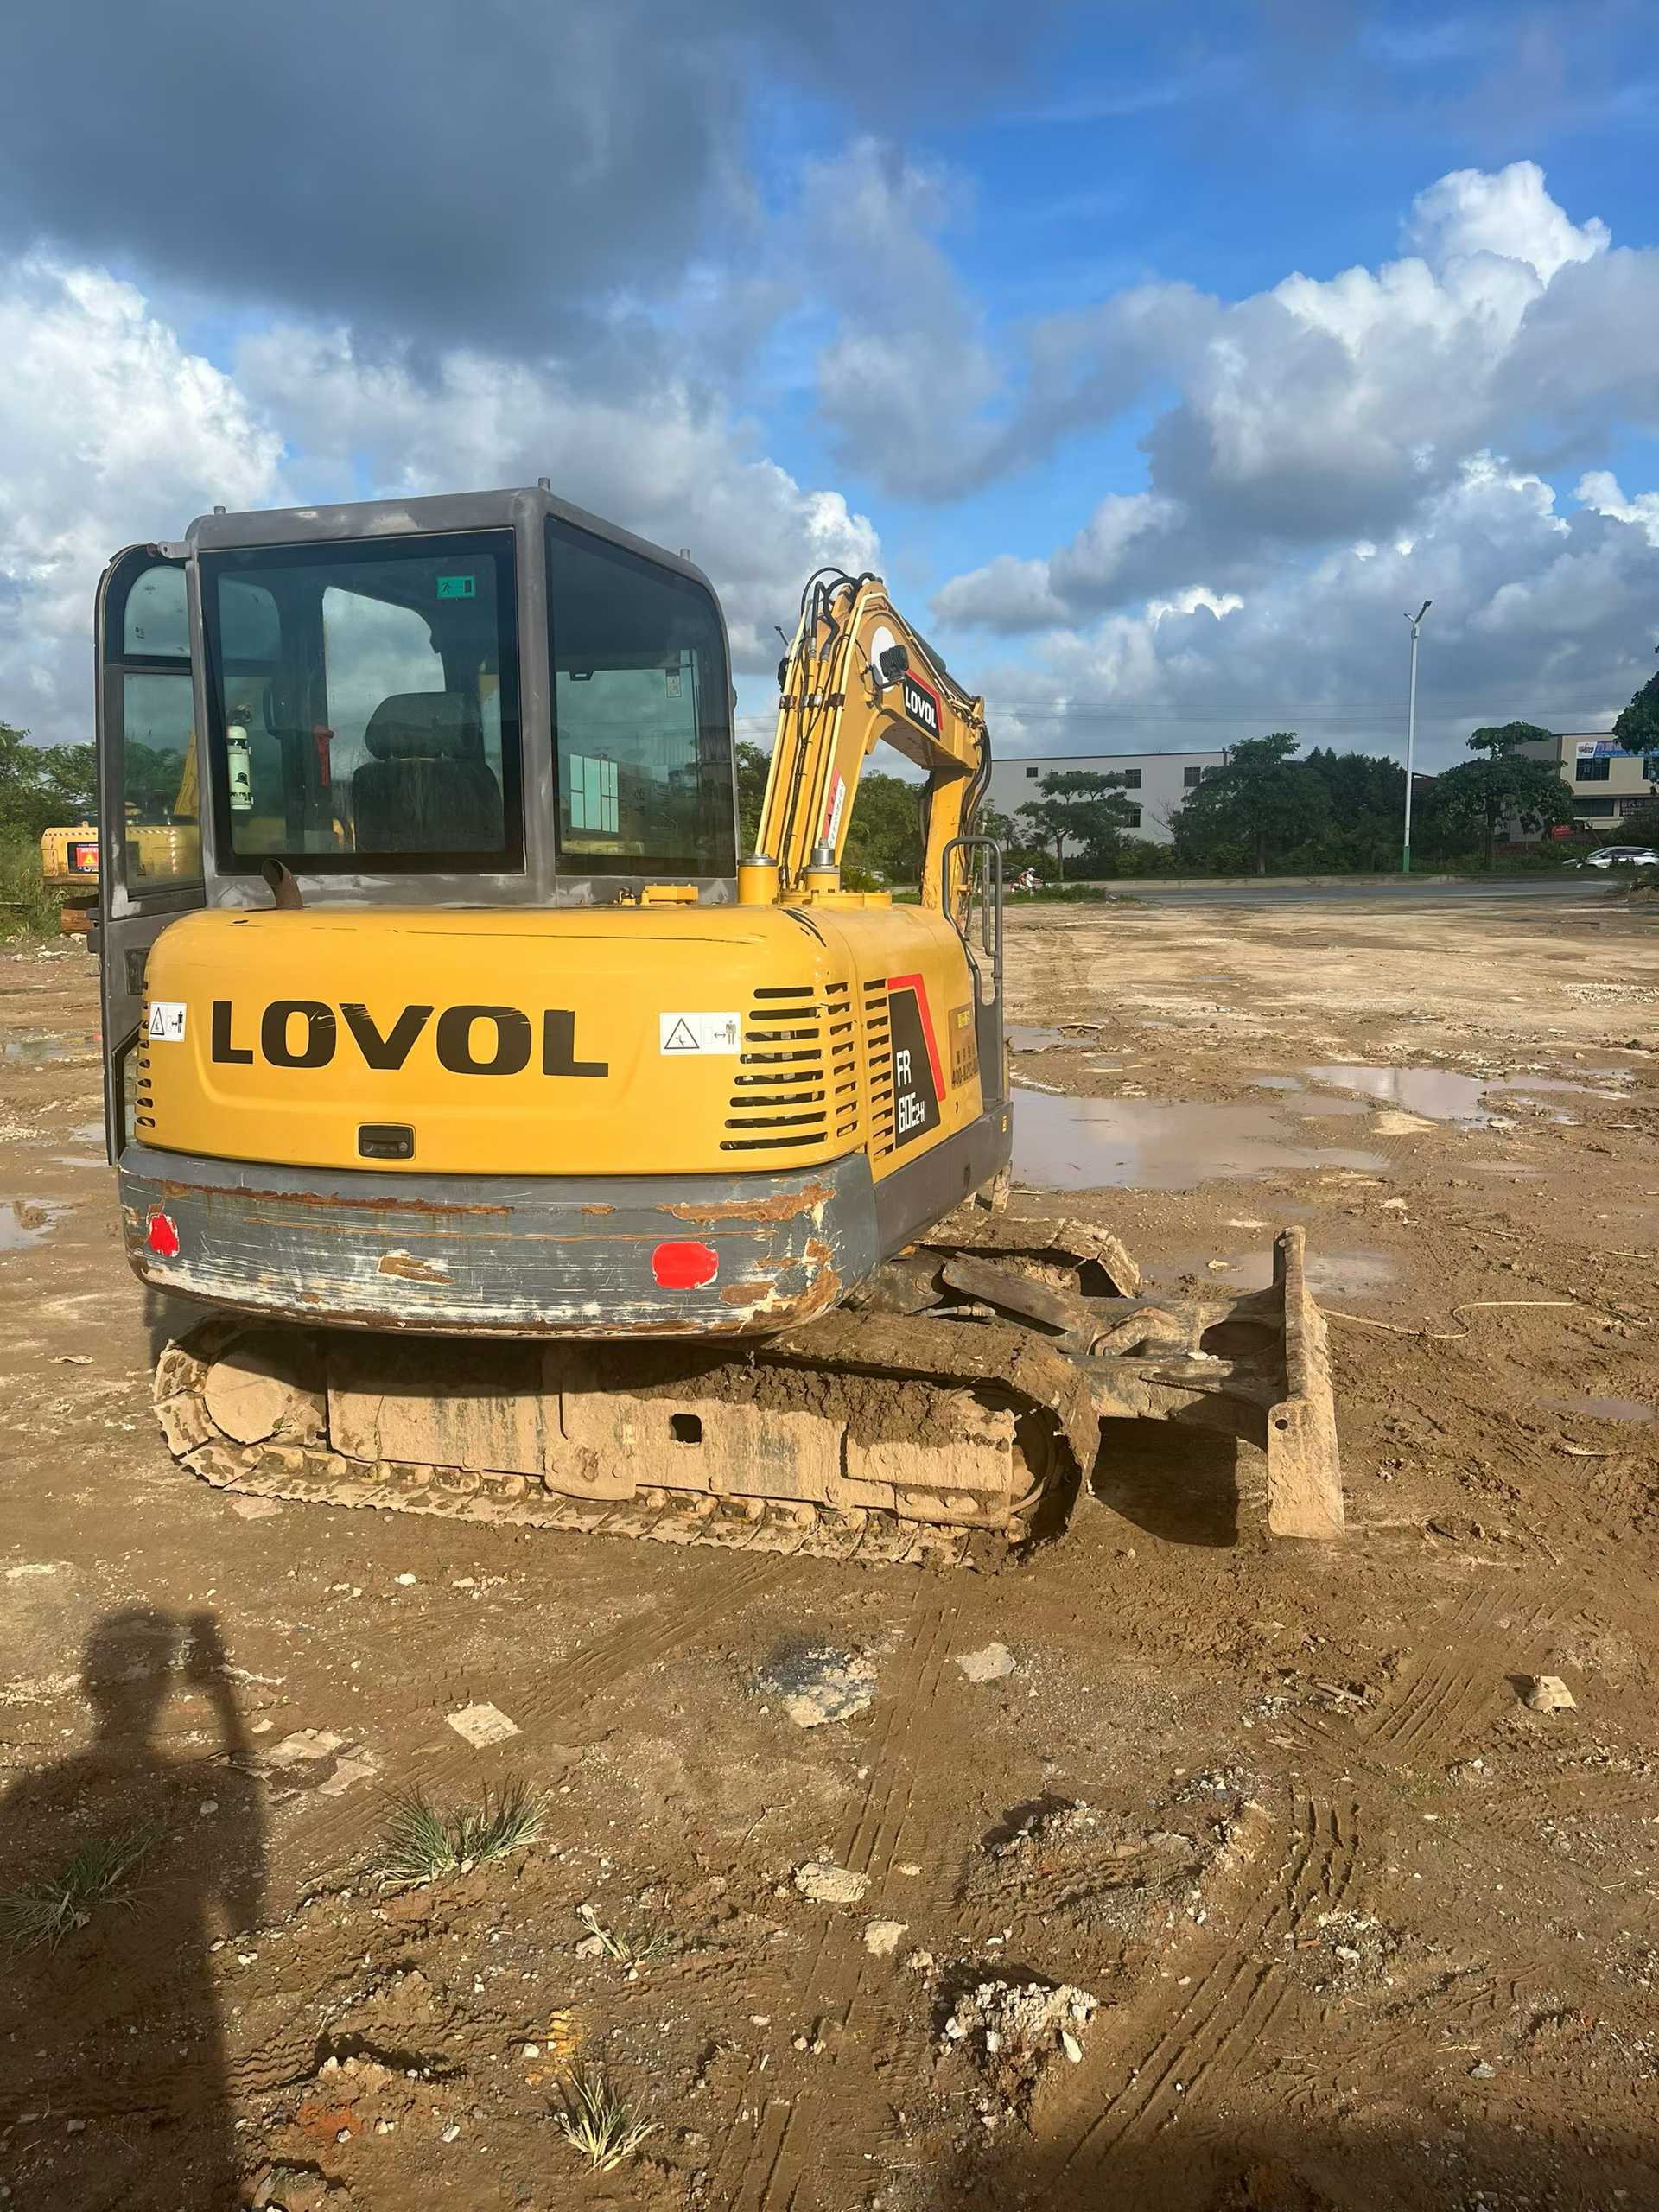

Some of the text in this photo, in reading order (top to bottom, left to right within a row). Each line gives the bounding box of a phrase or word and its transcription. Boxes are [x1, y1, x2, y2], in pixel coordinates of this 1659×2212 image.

[906, 685, 936, 728] LOVOL
[212, 1000, 609, 1077] LOVOL
[896, 1049, 912, 1088] FR
